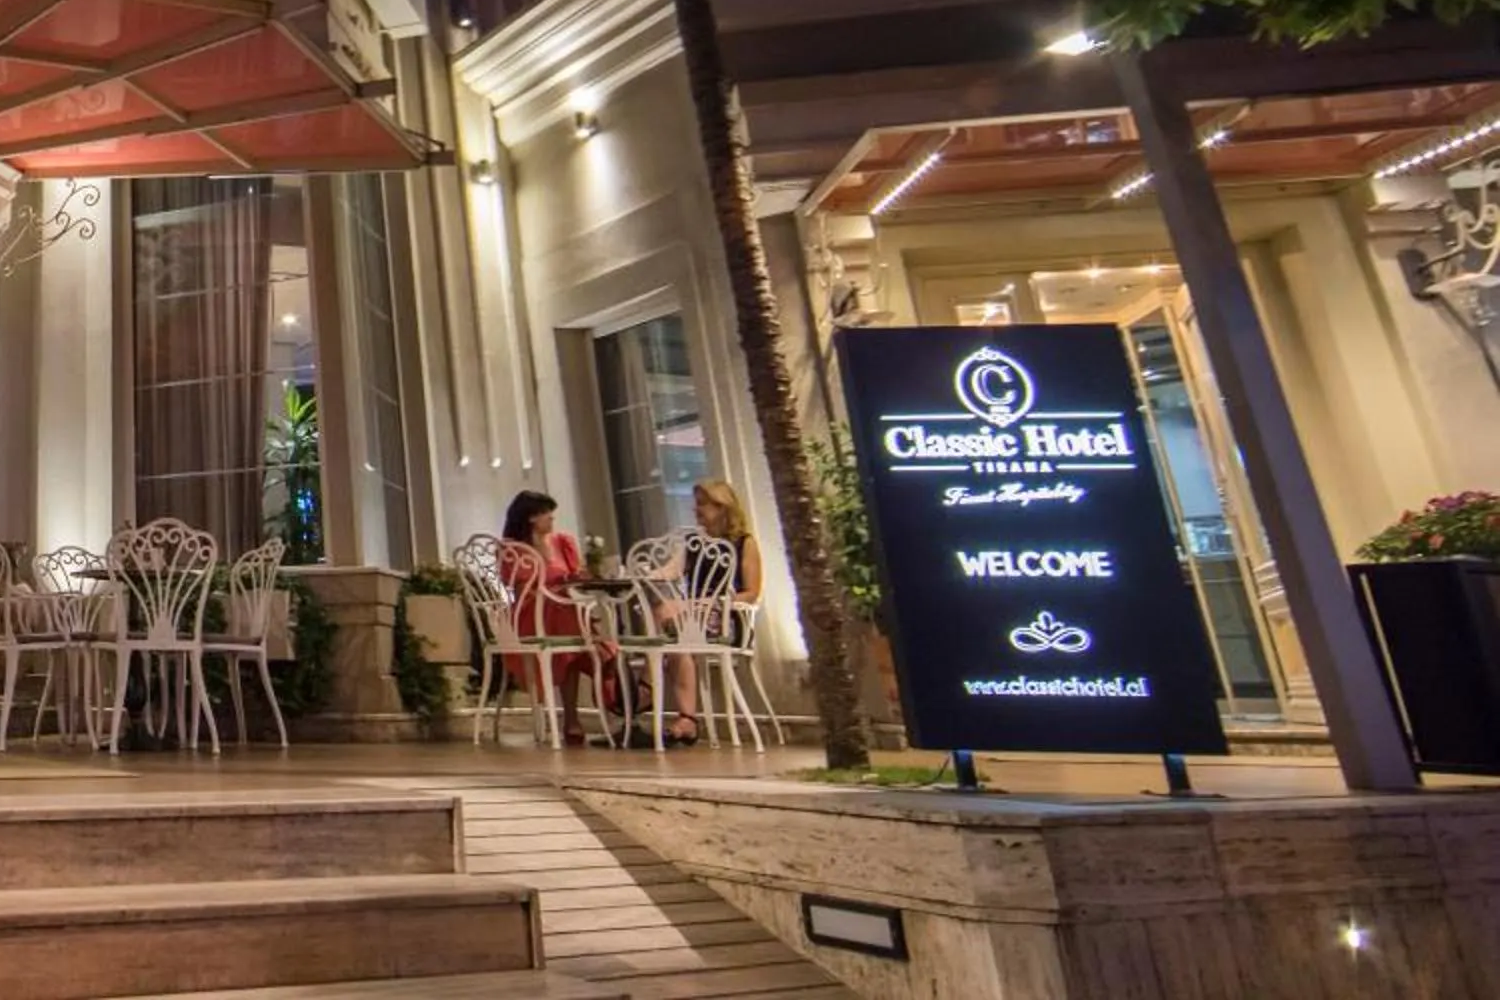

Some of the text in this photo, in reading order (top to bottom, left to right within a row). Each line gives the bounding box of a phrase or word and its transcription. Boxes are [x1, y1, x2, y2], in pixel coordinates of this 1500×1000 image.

[883, 424, 1133, 458] Classic Hotel
[972, 461, 1054, 473] TIRANA
[956, 551, 1113, 577] WELCOME
